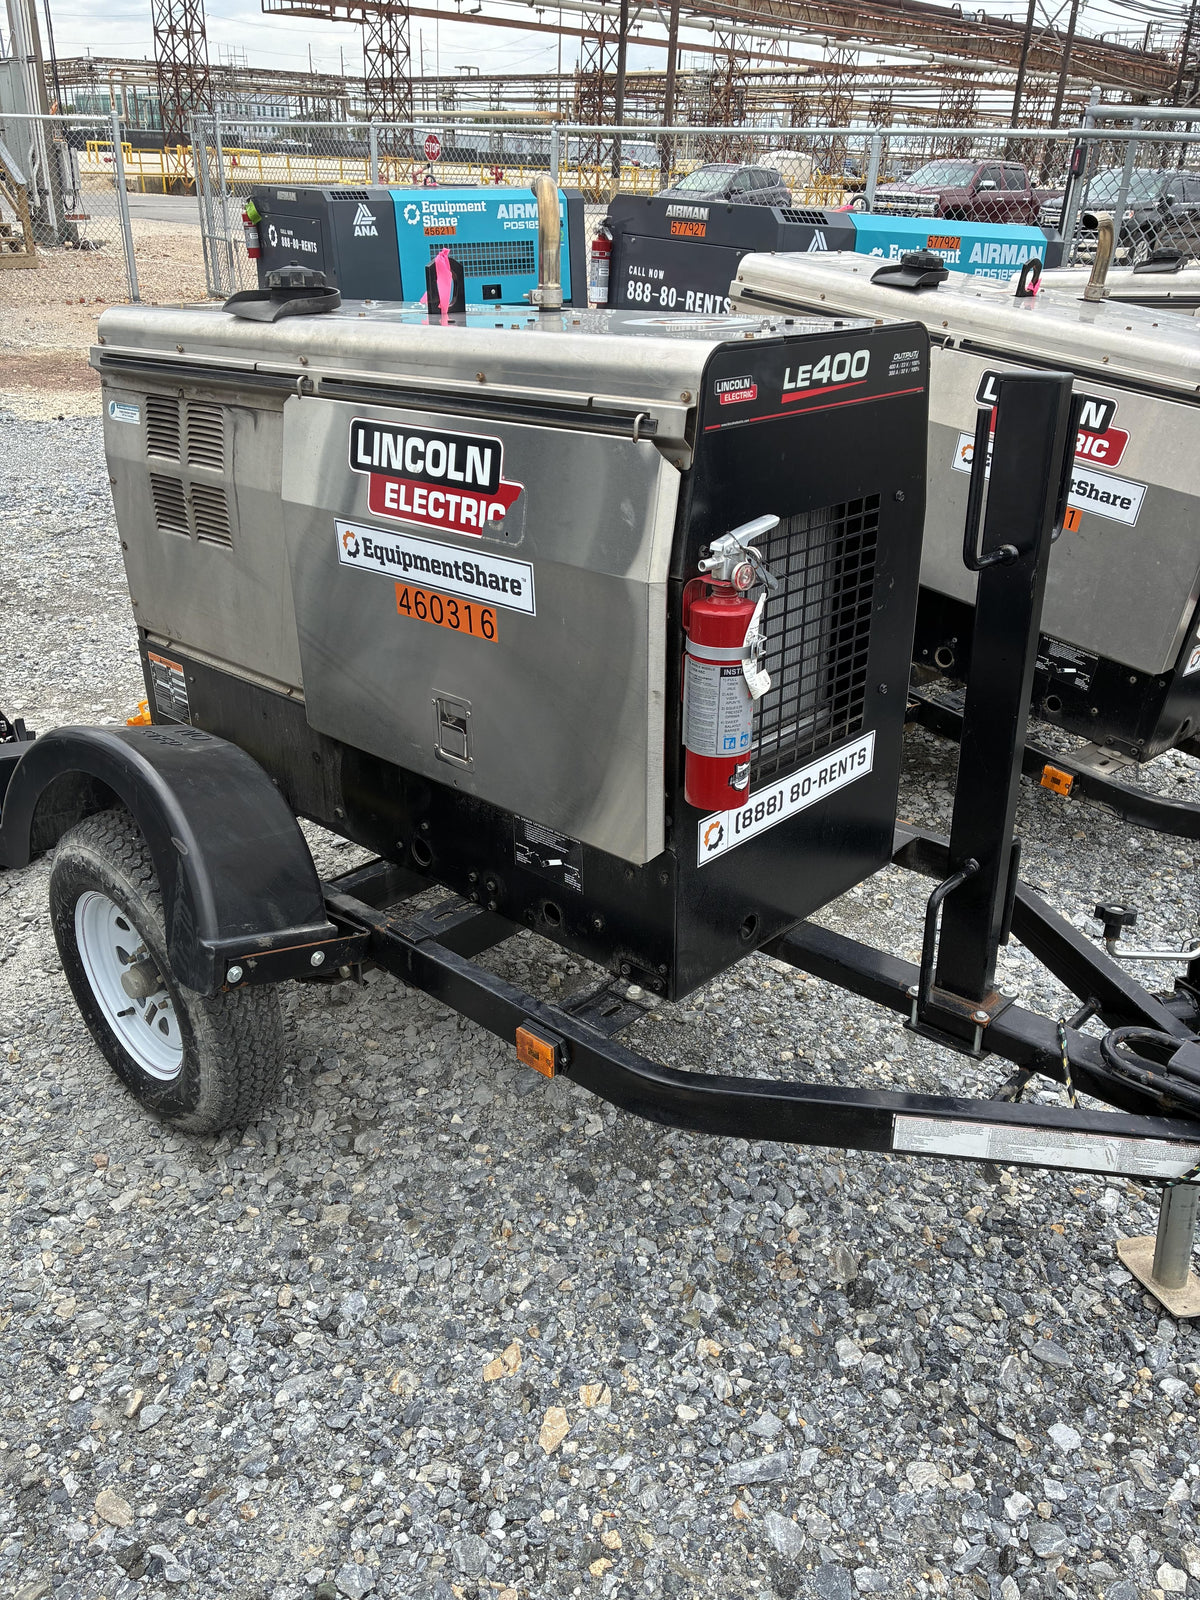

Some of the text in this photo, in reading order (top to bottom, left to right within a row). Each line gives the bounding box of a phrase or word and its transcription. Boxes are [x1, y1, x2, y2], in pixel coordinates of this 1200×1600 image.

[425, 141, 440, 154] STOP
[421, 201, 487, 215] Equipment
[665, 204, 710, 220] AIRMAN
[422, 215, 458, 227] Share
[671, 221, 706, 236] 577927
[353, 225, 379, 237] ANA
[424, 227, 456, 236] 456211
[928, 235, 961, 249] 577927
[969, 242, 1043, 265] AIRMAN
[628, 265, 665, 280] CALL NOW
[626, 280, 731, 314] 888-80-RENTS
[782, 349, 870, 390] LE400
[716, 378, 750, 393] LINCOLN
[724, 390, 754, 402] ELECTRIC
[357, 429, 492, 486] LINCOLN
[361, 536, 522, 597] EquipmentShare
[399, 588, 495, 640] 460316
[735, 790, 784, 834] (888)
[789, 747, 867, 803] 80-RENTS
